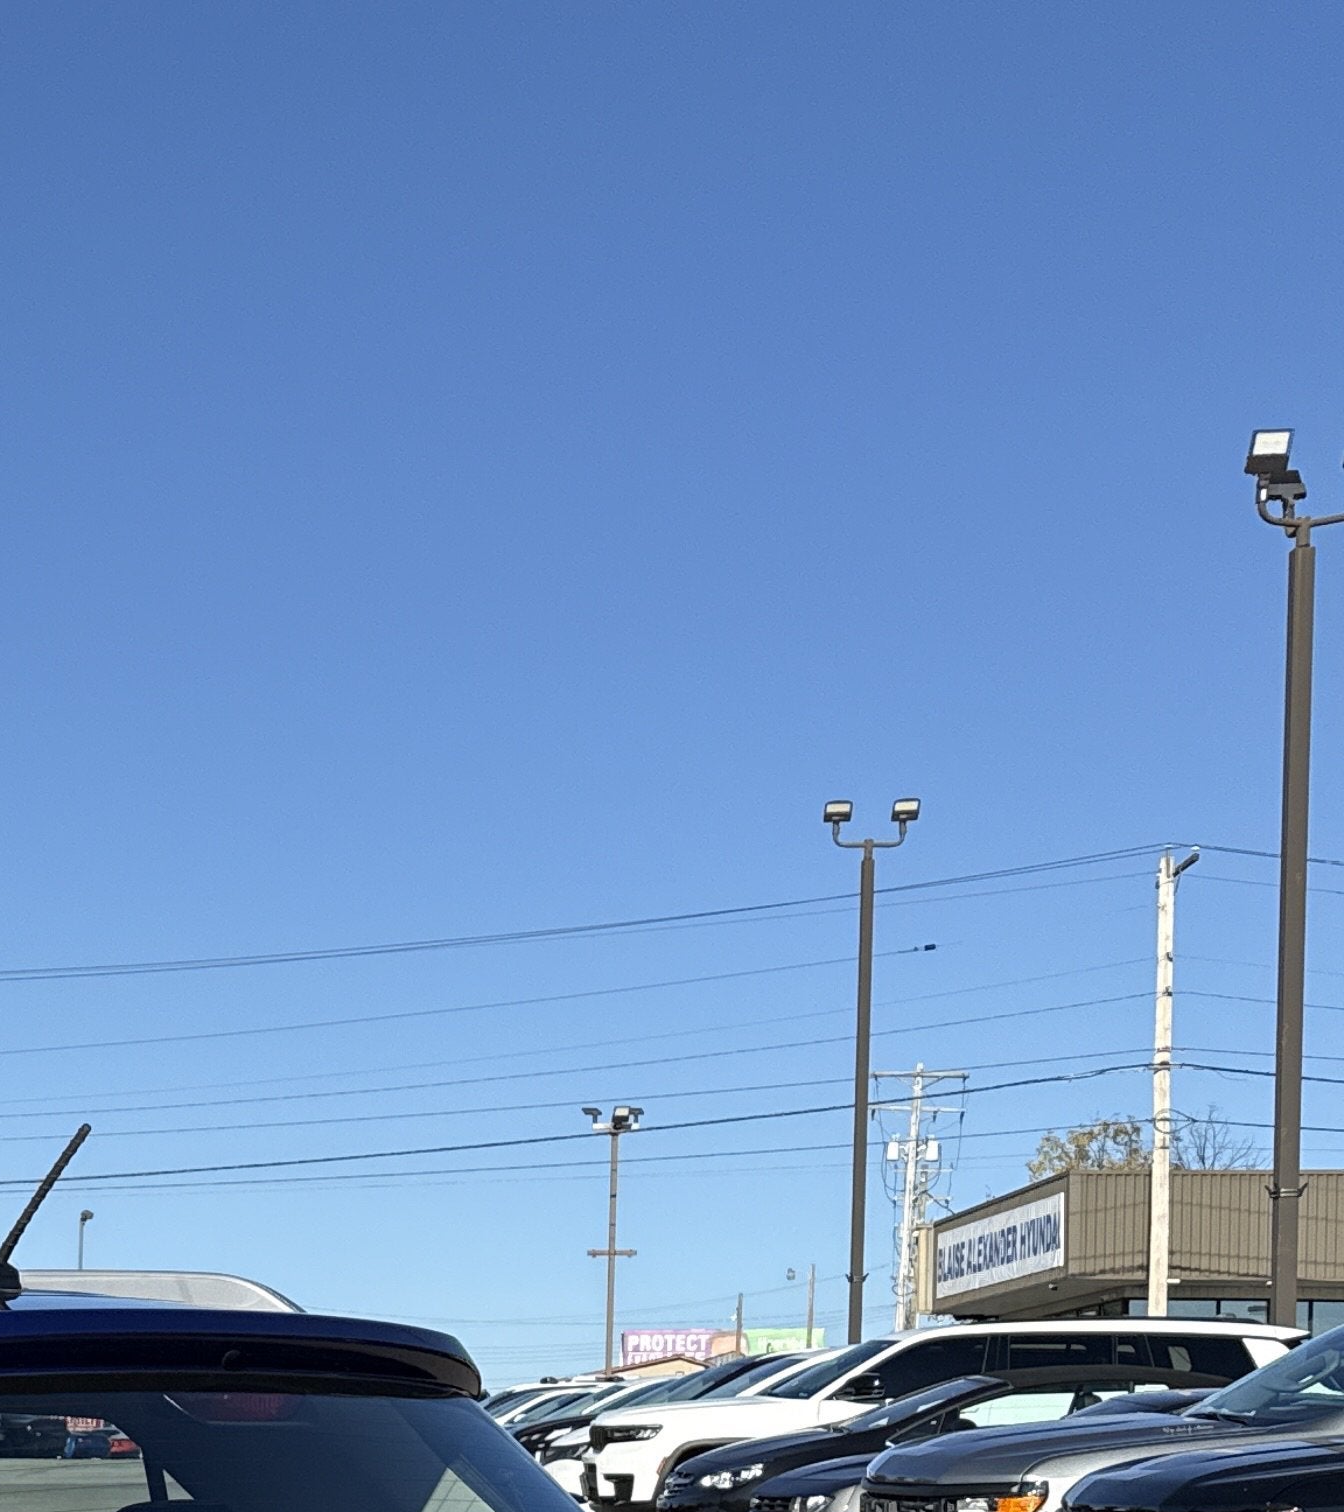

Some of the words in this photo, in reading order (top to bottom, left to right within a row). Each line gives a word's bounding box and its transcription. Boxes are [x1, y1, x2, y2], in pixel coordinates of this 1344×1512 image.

[937, 1241, 965, 1284] BLAISE
[966, 1225, 1018, 1276] ALEXANDER
[1019, 1210, 1061, 1261] HYUNDAI
[627, 1334, 710, 1352] PROTECT
